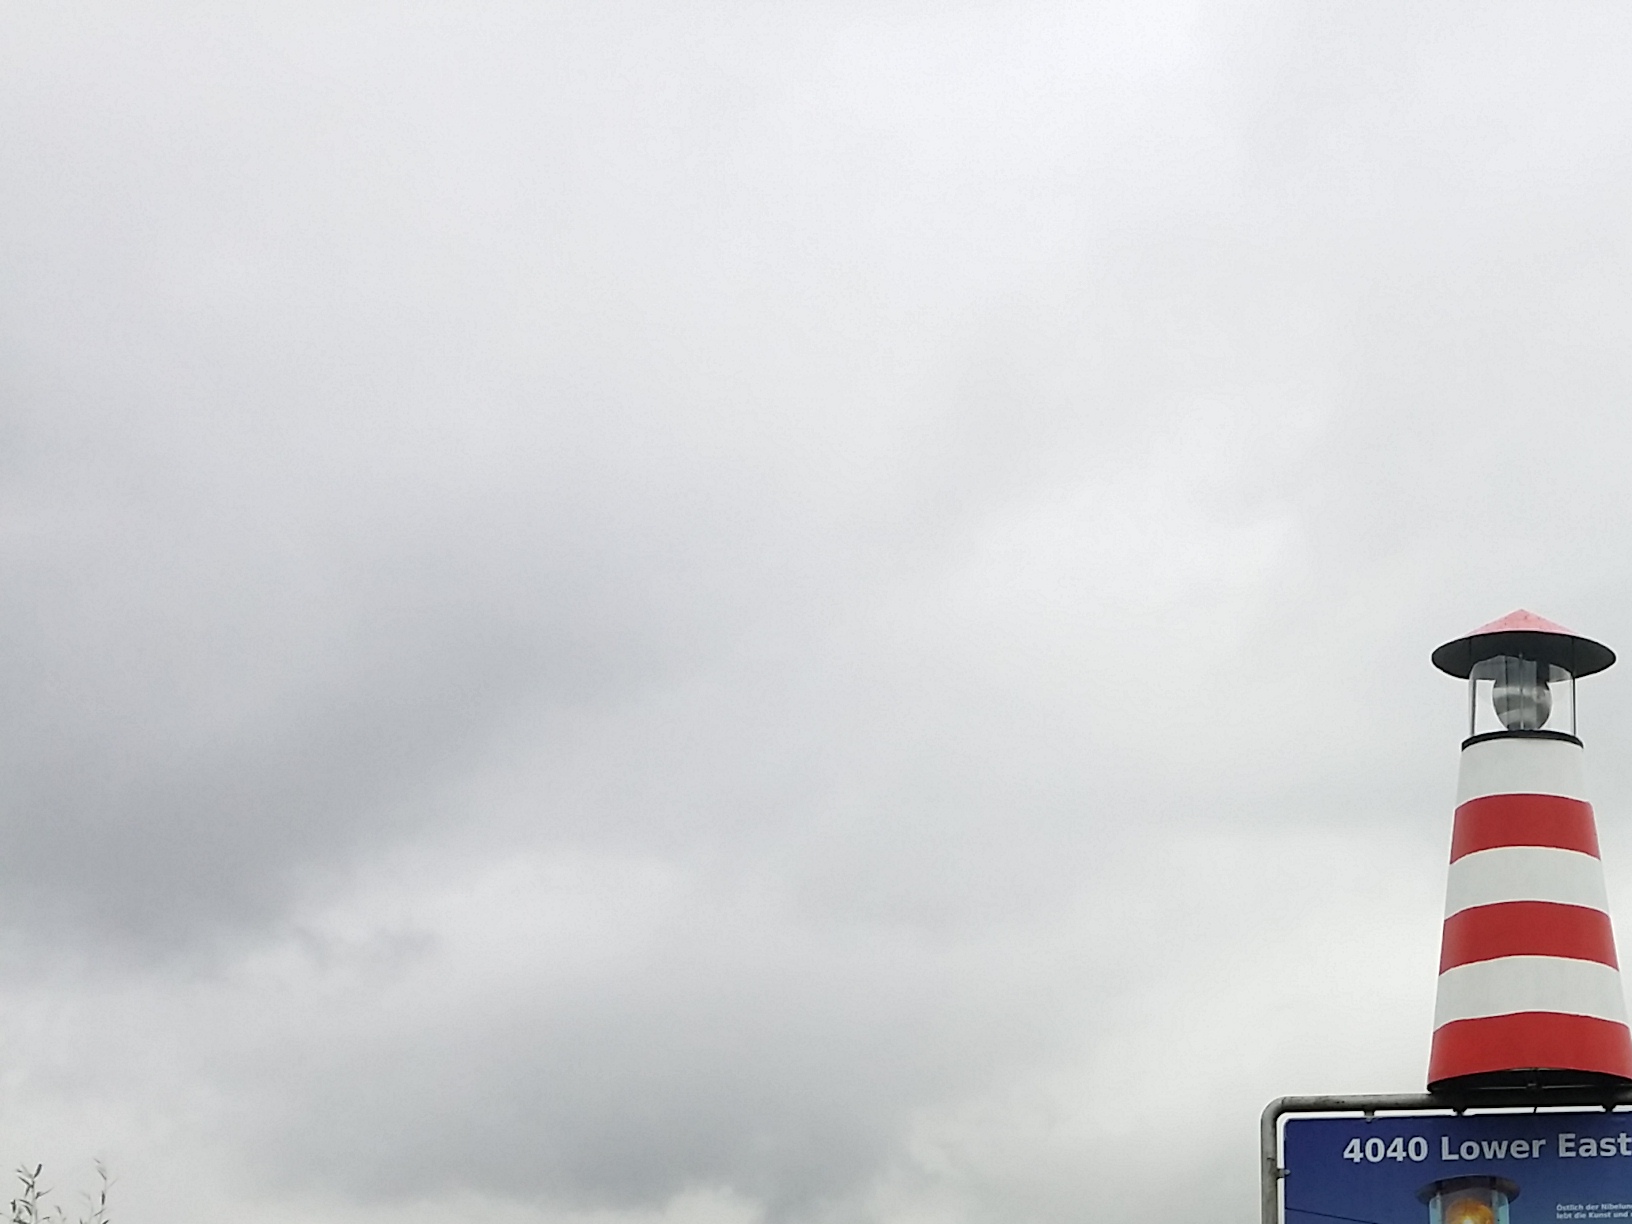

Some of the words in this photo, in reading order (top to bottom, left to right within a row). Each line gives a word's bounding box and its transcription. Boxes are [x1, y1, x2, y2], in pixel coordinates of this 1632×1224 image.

[1343, 1137, 1429, 1163] 4040
[1441, 1135, 1547, 1161] Lower
[1556, 1203, 1584, 1211] Östlich
[1574, 1211, 1587, 1219] die
[1588, 1211, 1611, 1219] Kunst
[1613, 1210, 1629, 1218] und
